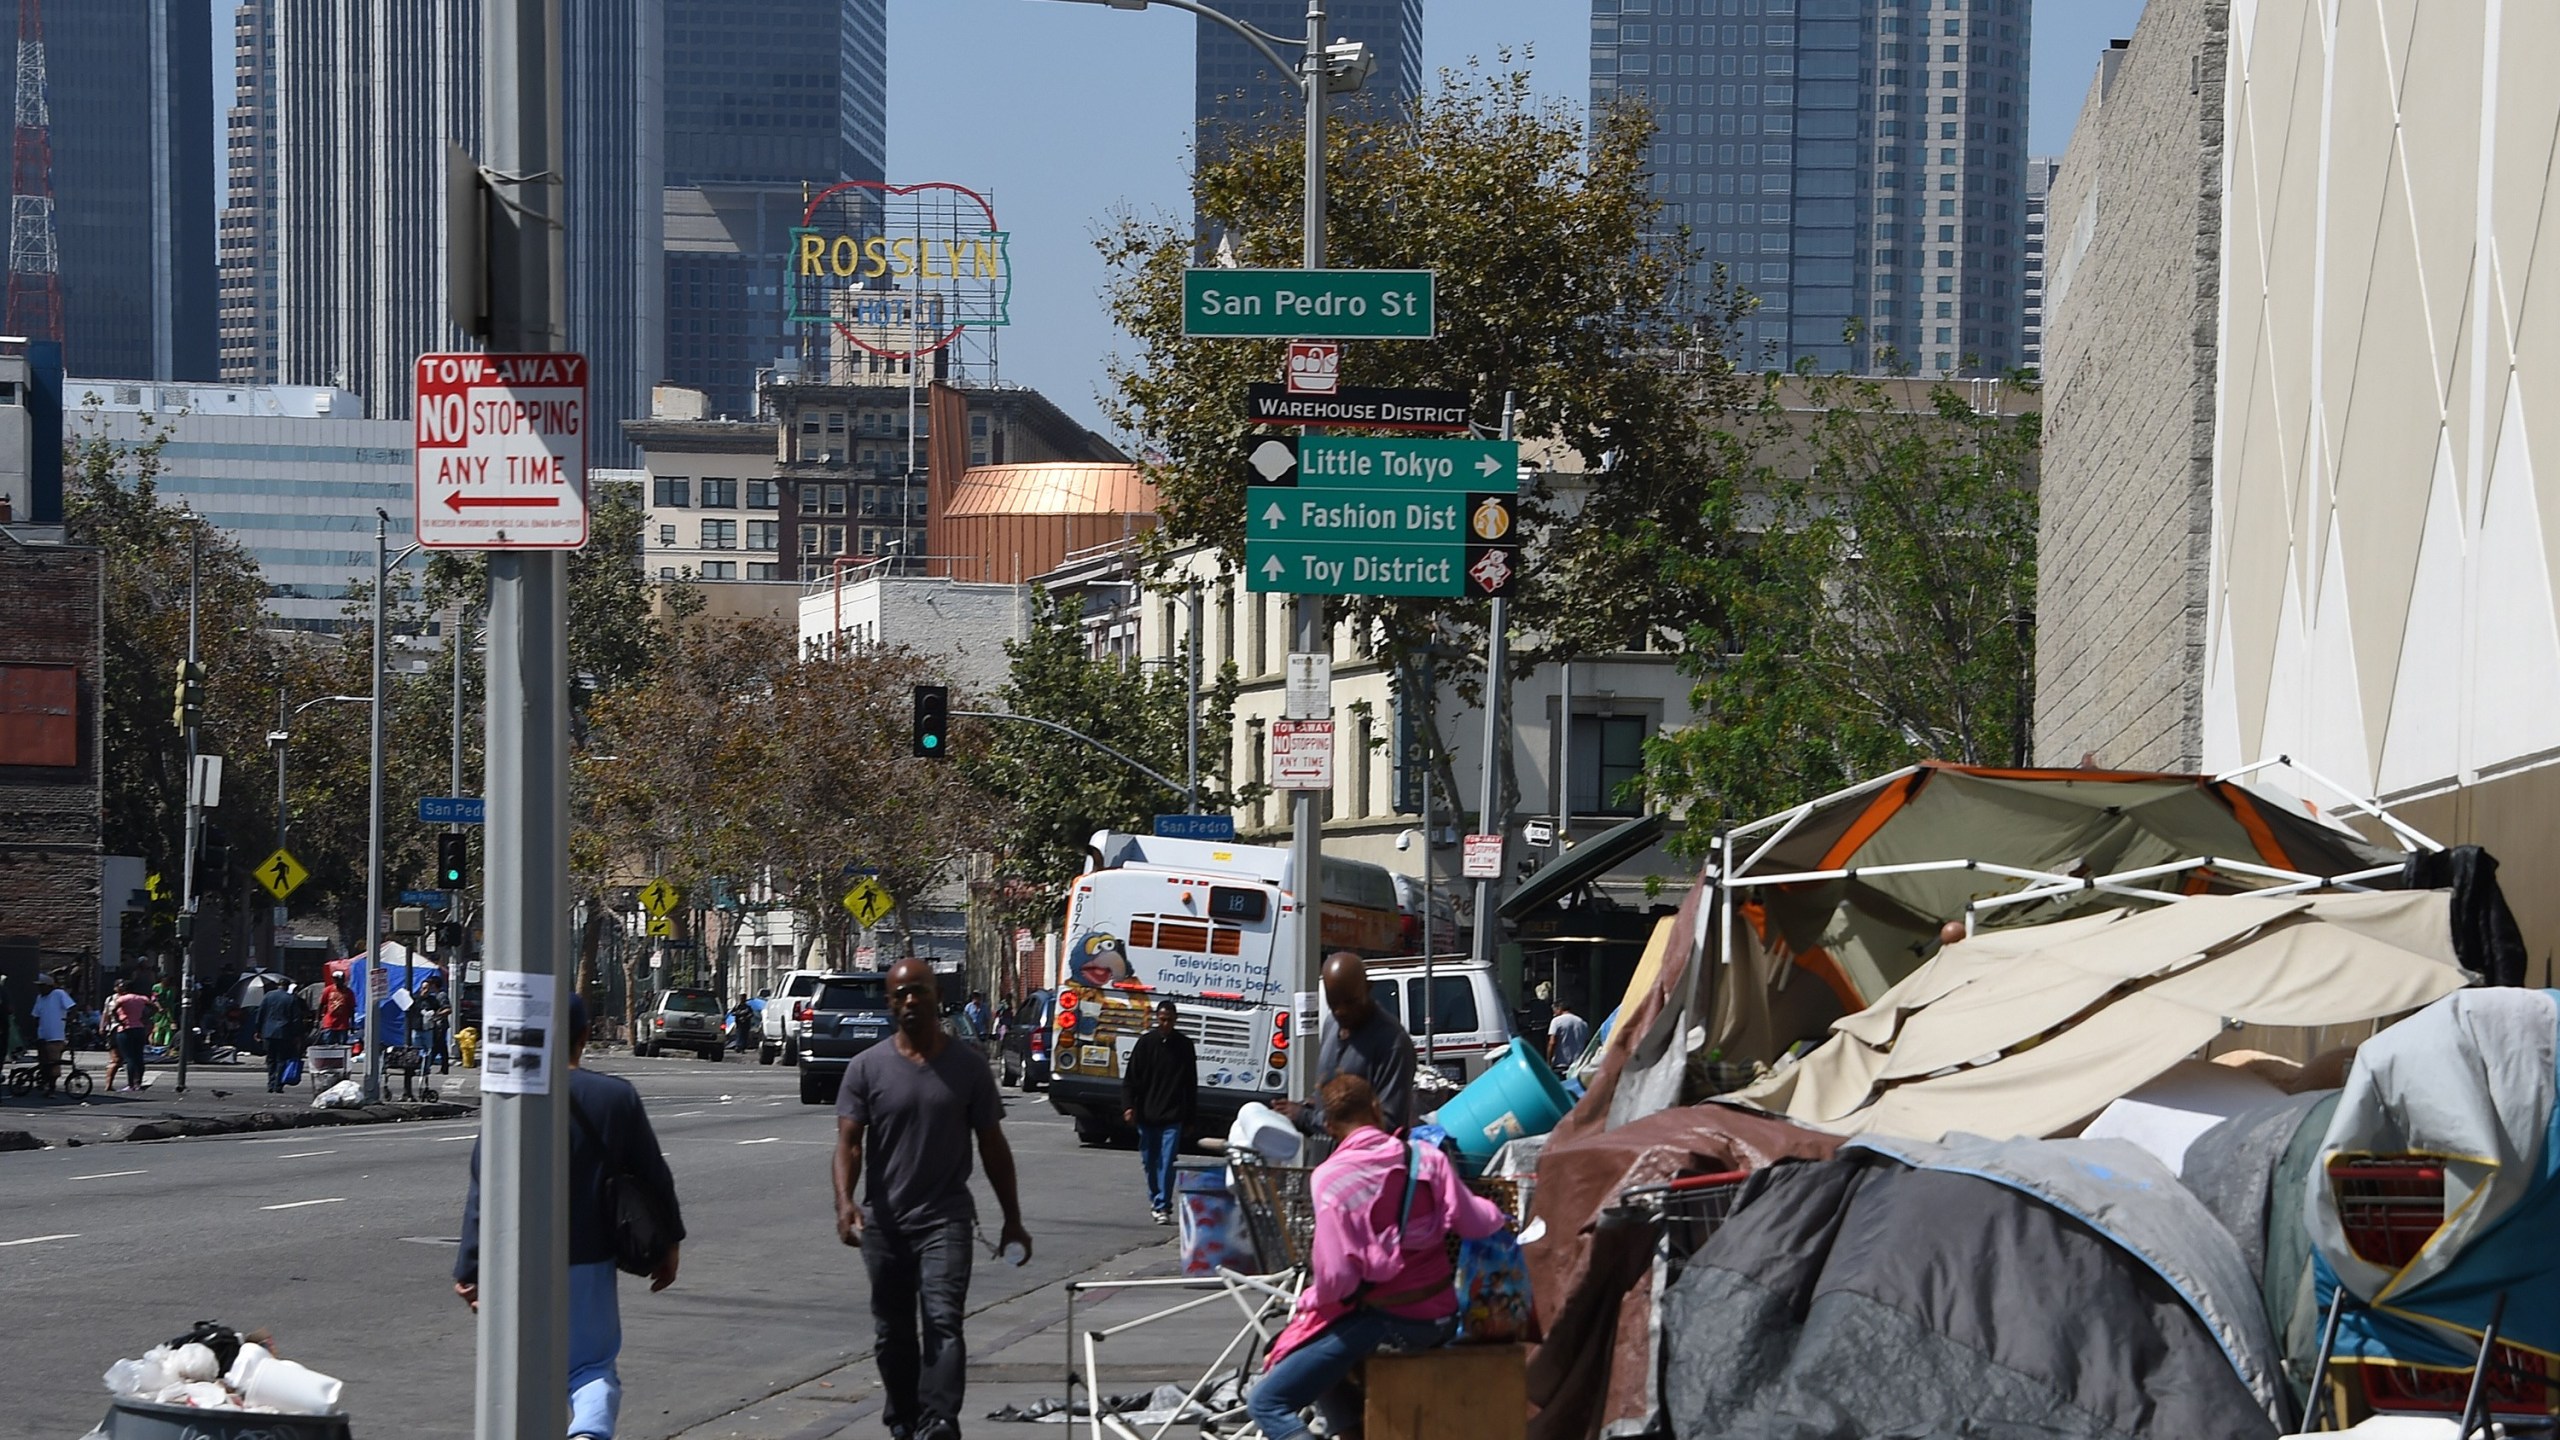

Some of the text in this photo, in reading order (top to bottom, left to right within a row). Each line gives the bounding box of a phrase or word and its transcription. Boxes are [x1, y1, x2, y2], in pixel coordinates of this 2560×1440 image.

[801, 234, 997, 280] ROSSLYN
[1201, 289, 1417, 318] San Pedro St
[422, 358, 581, 384] TOW-AWAY
[420, 393, 578, 443] NO STOPPING
[437, 456, 489, 484] ANY
[506, 456, 565, 484] TIME
[1303, 449, 1453, 483] Little Tokyo
[1302, 502, 1456, 531] Fashion Dist
[1302, 555, 1450, 586] Toy District
[1275, 723, 1331, 733] TOW-AWAY
[1273, 735, 1329, 753] NO STOPPING
[1279, 757, 1324, 768] ANY TIME
[425, 802, 450, 816] San
[1161, 820, 1229, 834] San Pedro
[1072, 893, 1084, 933] 6077
[1228, 894, 1245, 912] 18
[1173, 955, 1269, 976] Television has
[1158, 969, 1285, 994] finally hit its beak.
